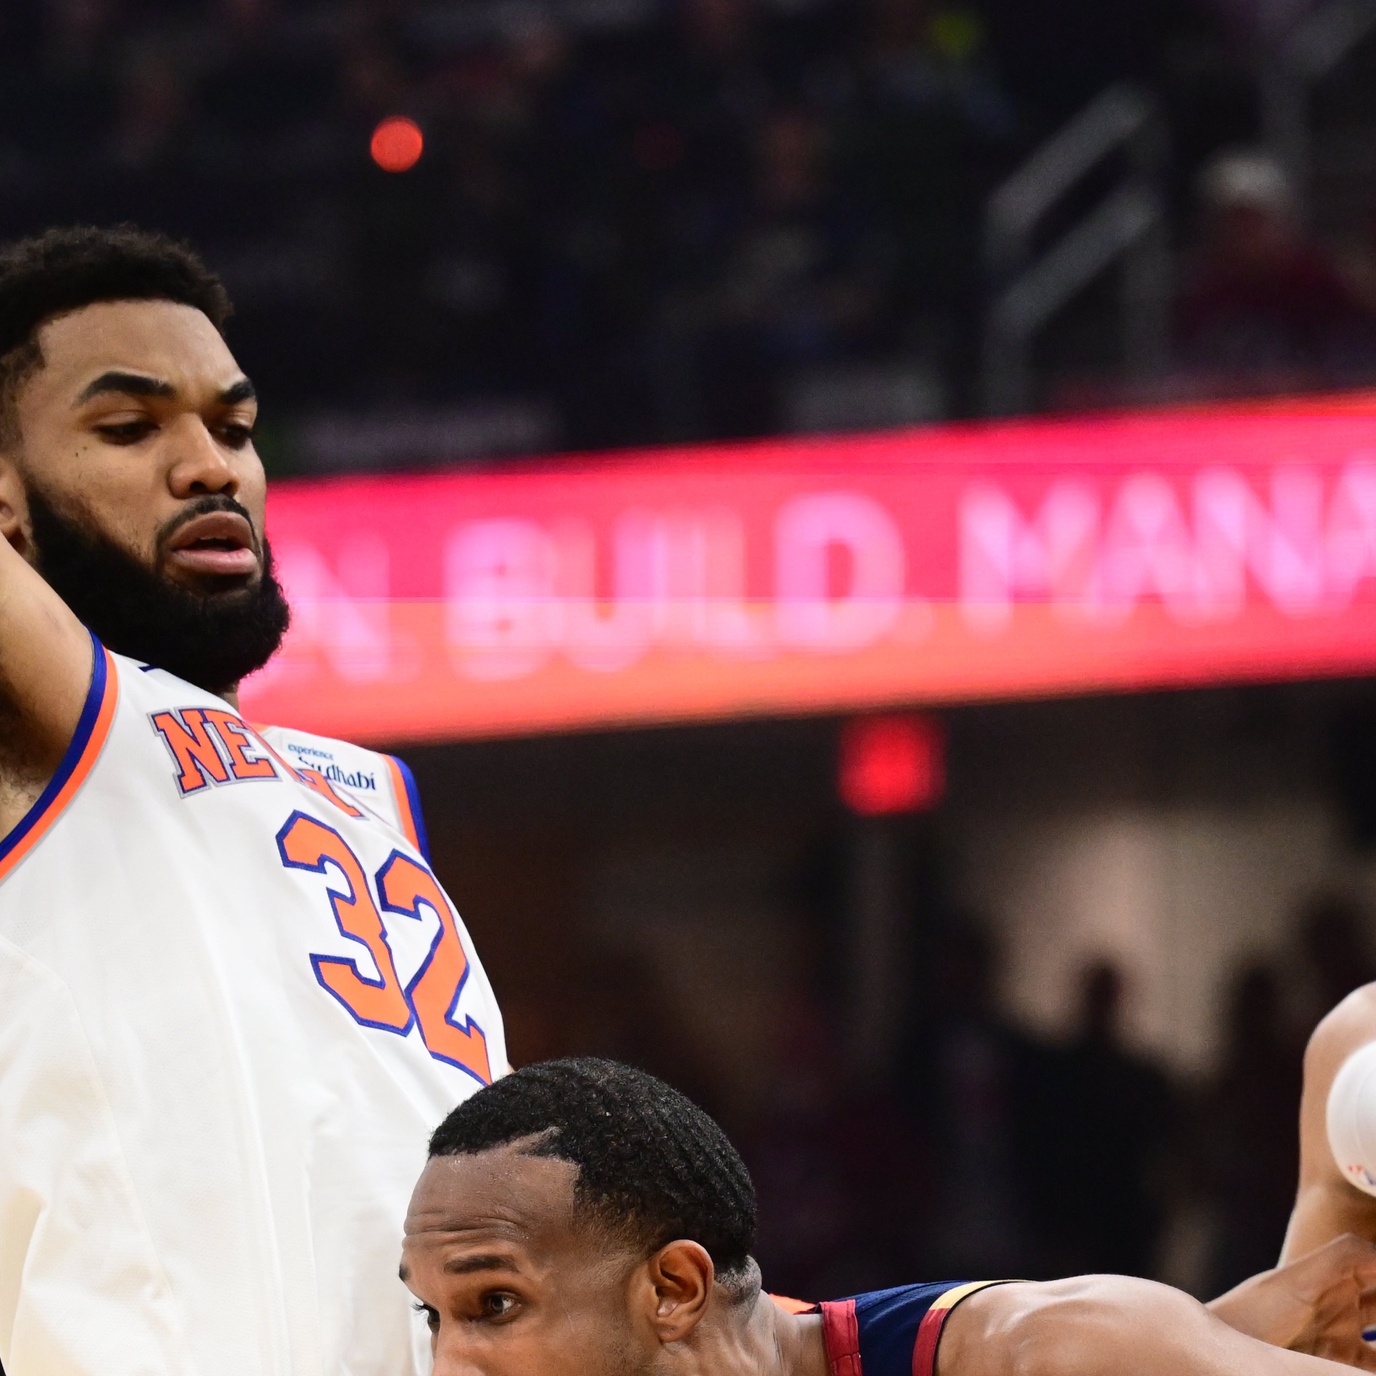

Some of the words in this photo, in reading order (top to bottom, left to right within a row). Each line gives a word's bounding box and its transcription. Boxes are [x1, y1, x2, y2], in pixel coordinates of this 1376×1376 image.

[146, 705, 284, 798] NE
[287, 742, 334, 761] experience
[276, 809, 493, 1088] 32
